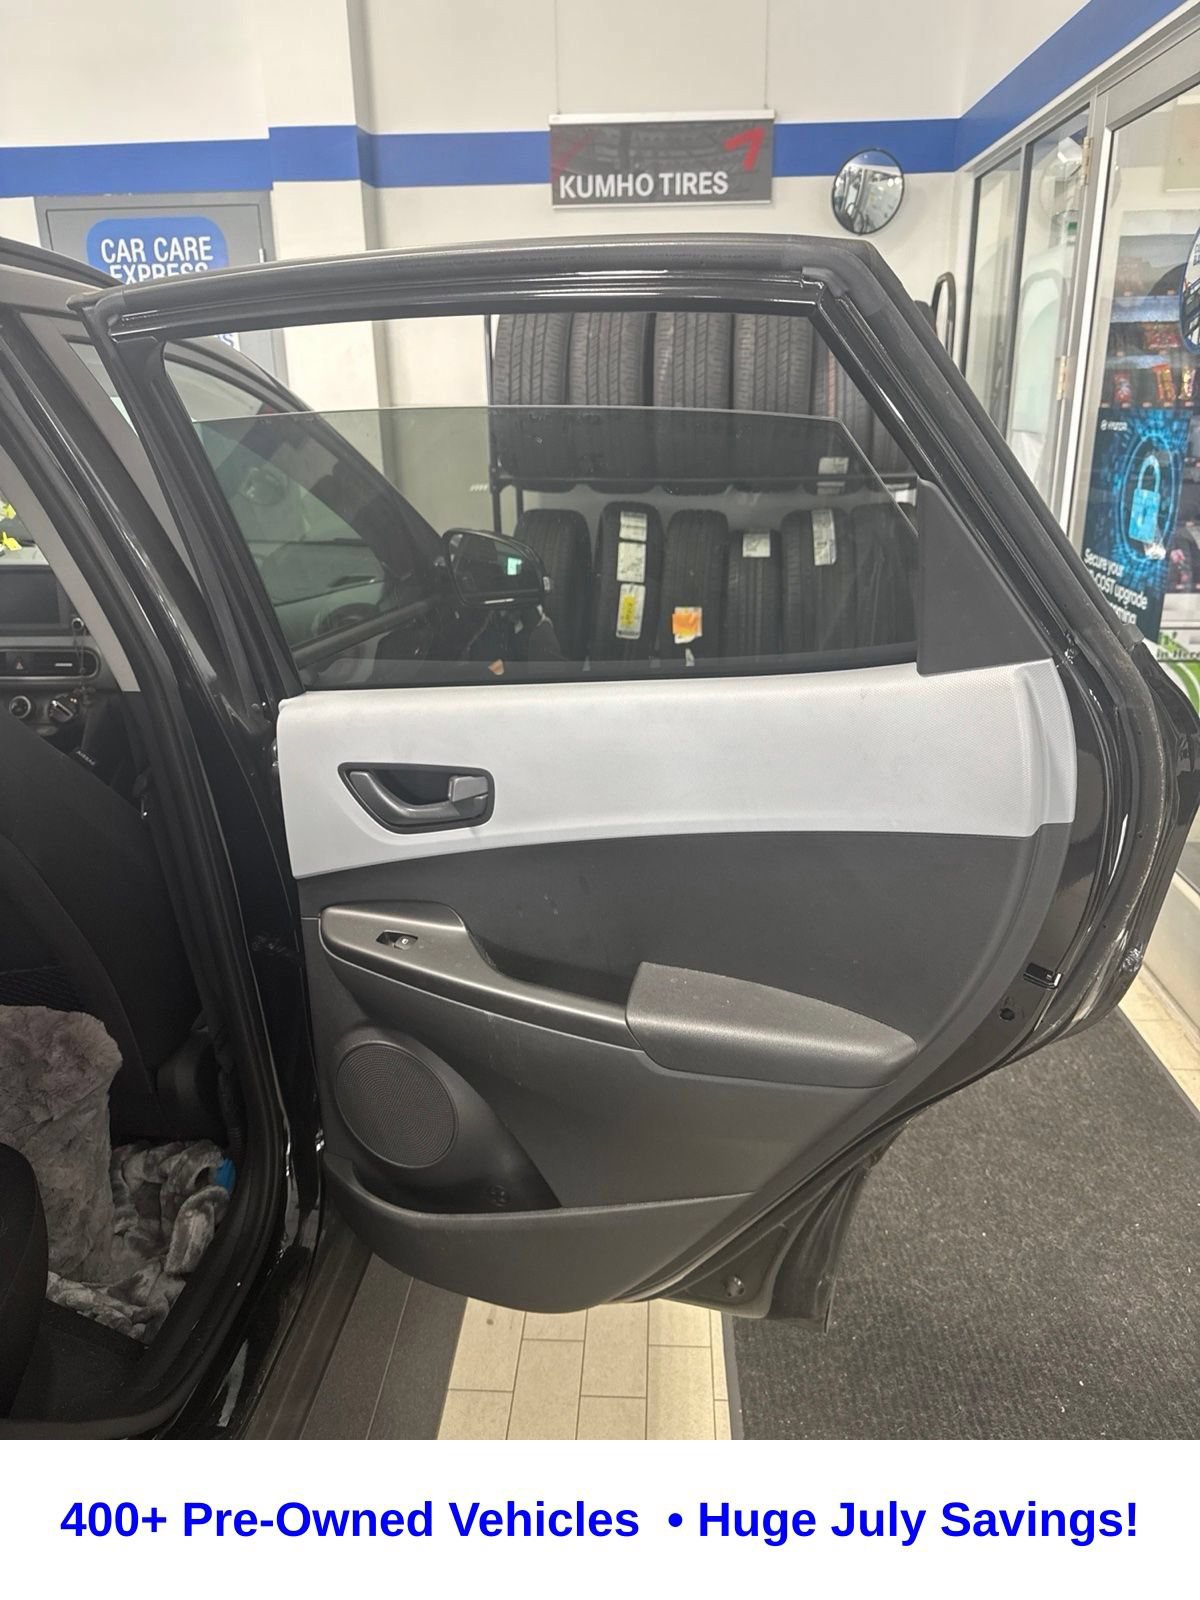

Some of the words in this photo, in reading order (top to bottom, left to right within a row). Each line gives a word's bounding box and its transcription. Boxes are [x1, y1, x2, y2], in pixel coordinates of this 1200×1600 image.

[559, 173, 654, 198] KUMHO
[659, 171, 729, 196] TIRES
[101, 238, 147, 263] CAR
[153, 236, 214, 262] CARE
